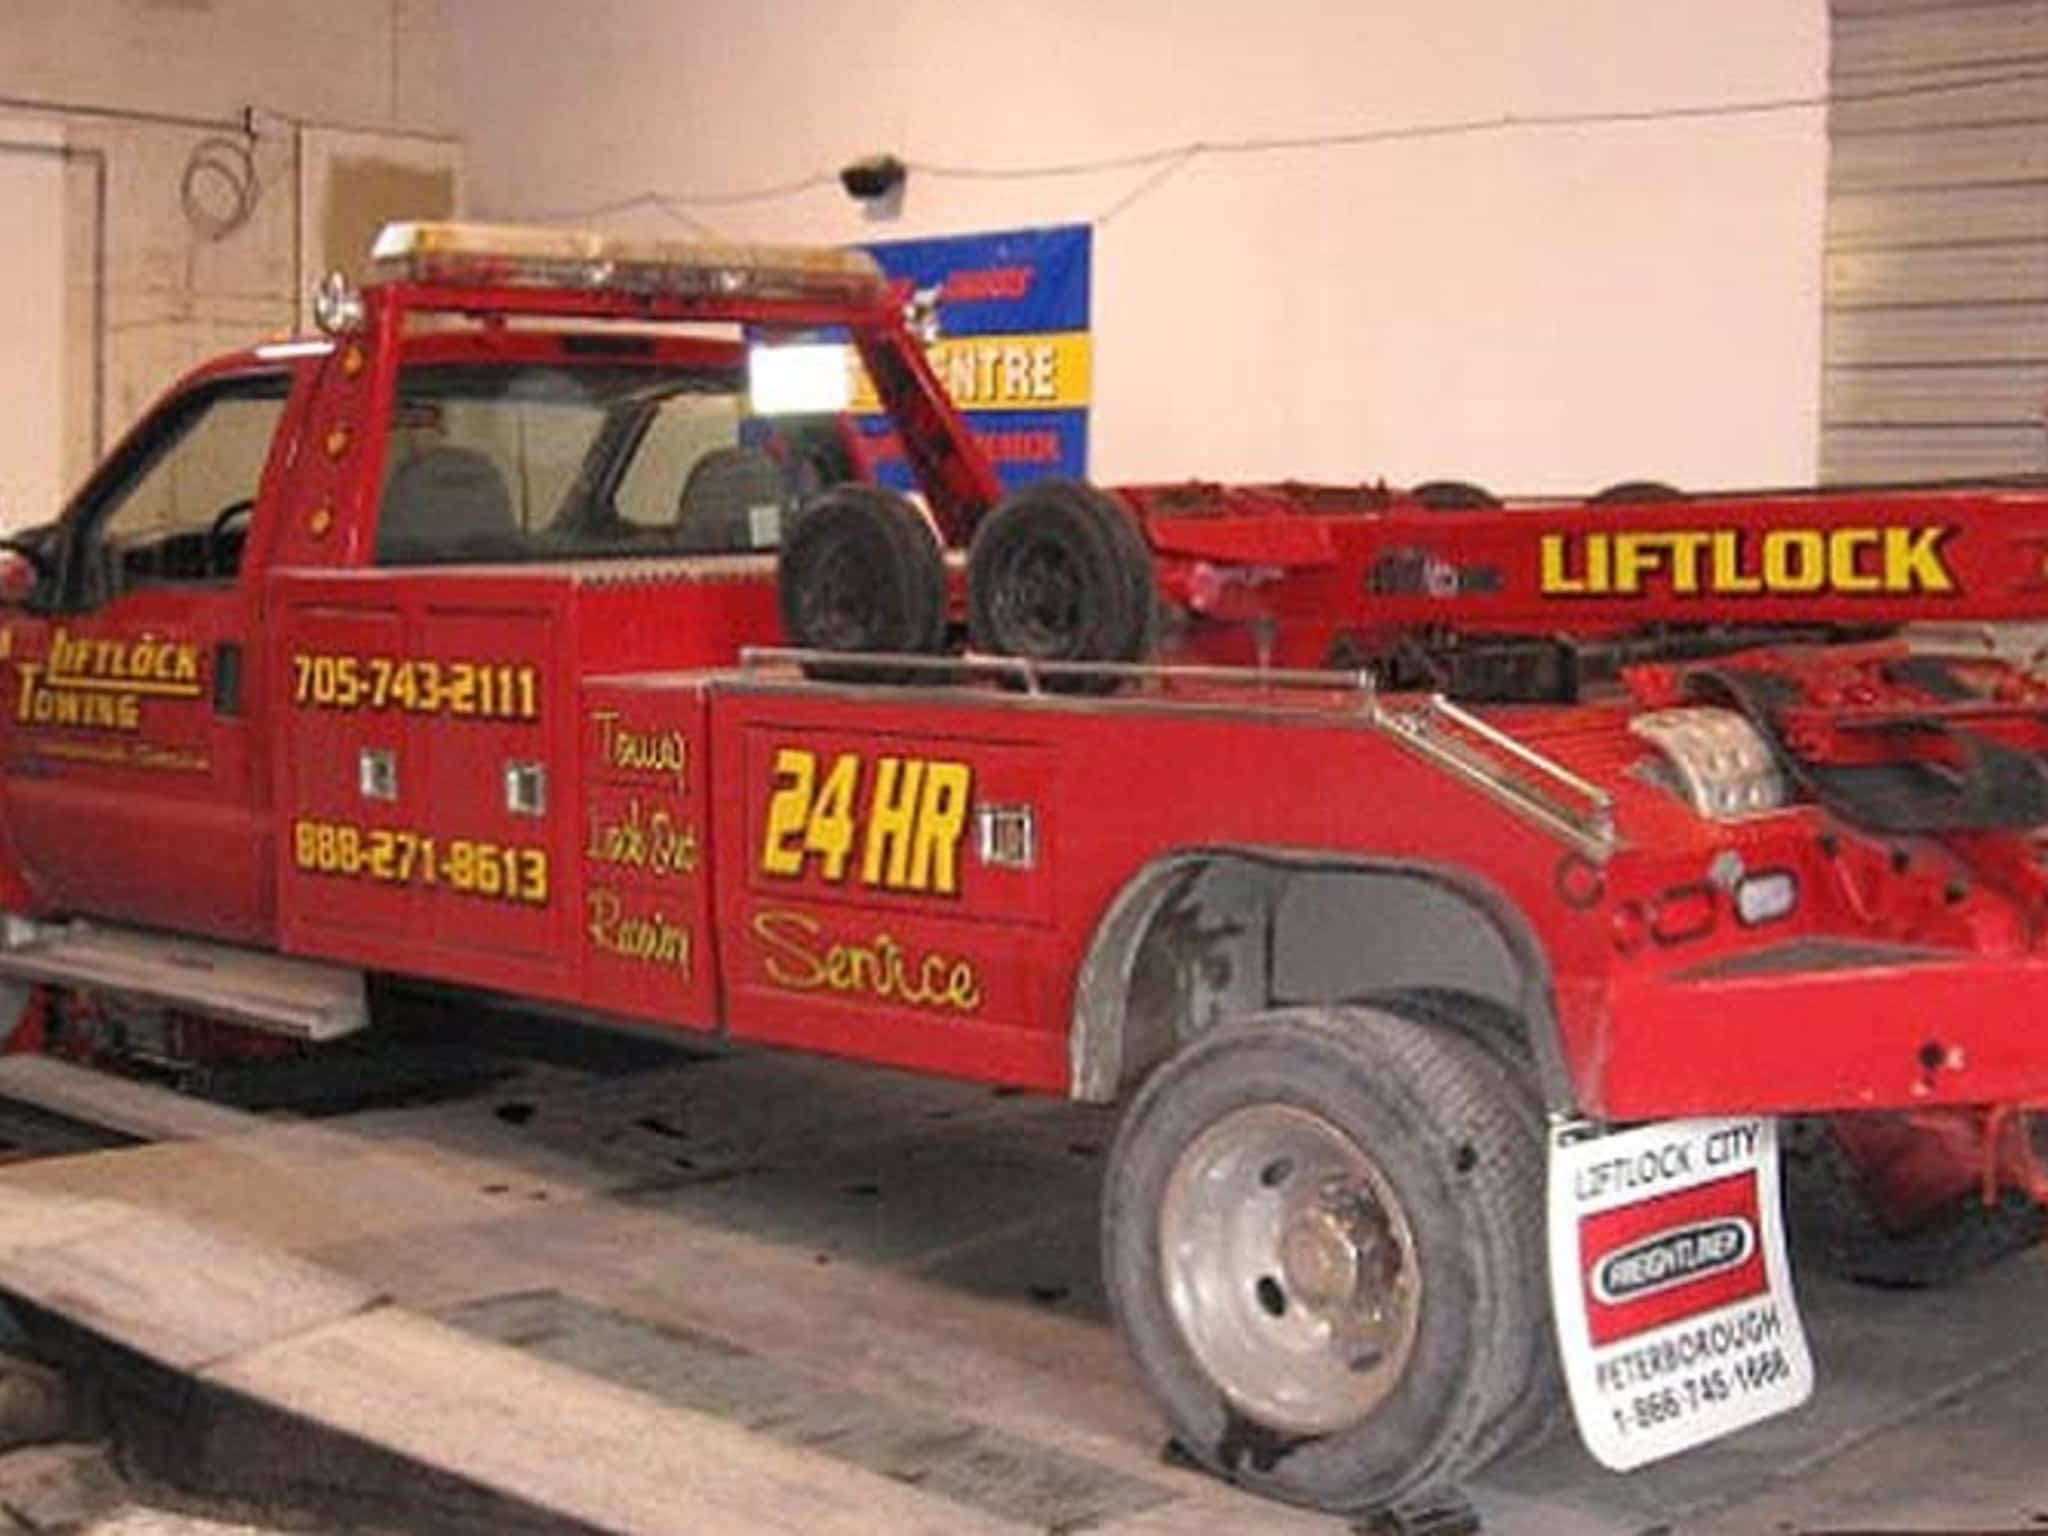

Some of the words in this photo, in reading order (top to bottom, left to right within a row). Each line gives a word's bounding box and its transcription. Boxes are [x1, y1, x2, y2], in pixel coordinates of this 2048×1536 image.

[1540, 527, 1955, 594] LIFTLOCK
[294, 655, 537, 717] 705-743-2111
[762, 748, 859, 880] 24
[861, 757, 971, 892] HR
[754, 911, 981, 1009] Service
[1575, 1142, 1694, 1202] LIFTLOCK
[1705, 1121, 1761, 1166] CITY
